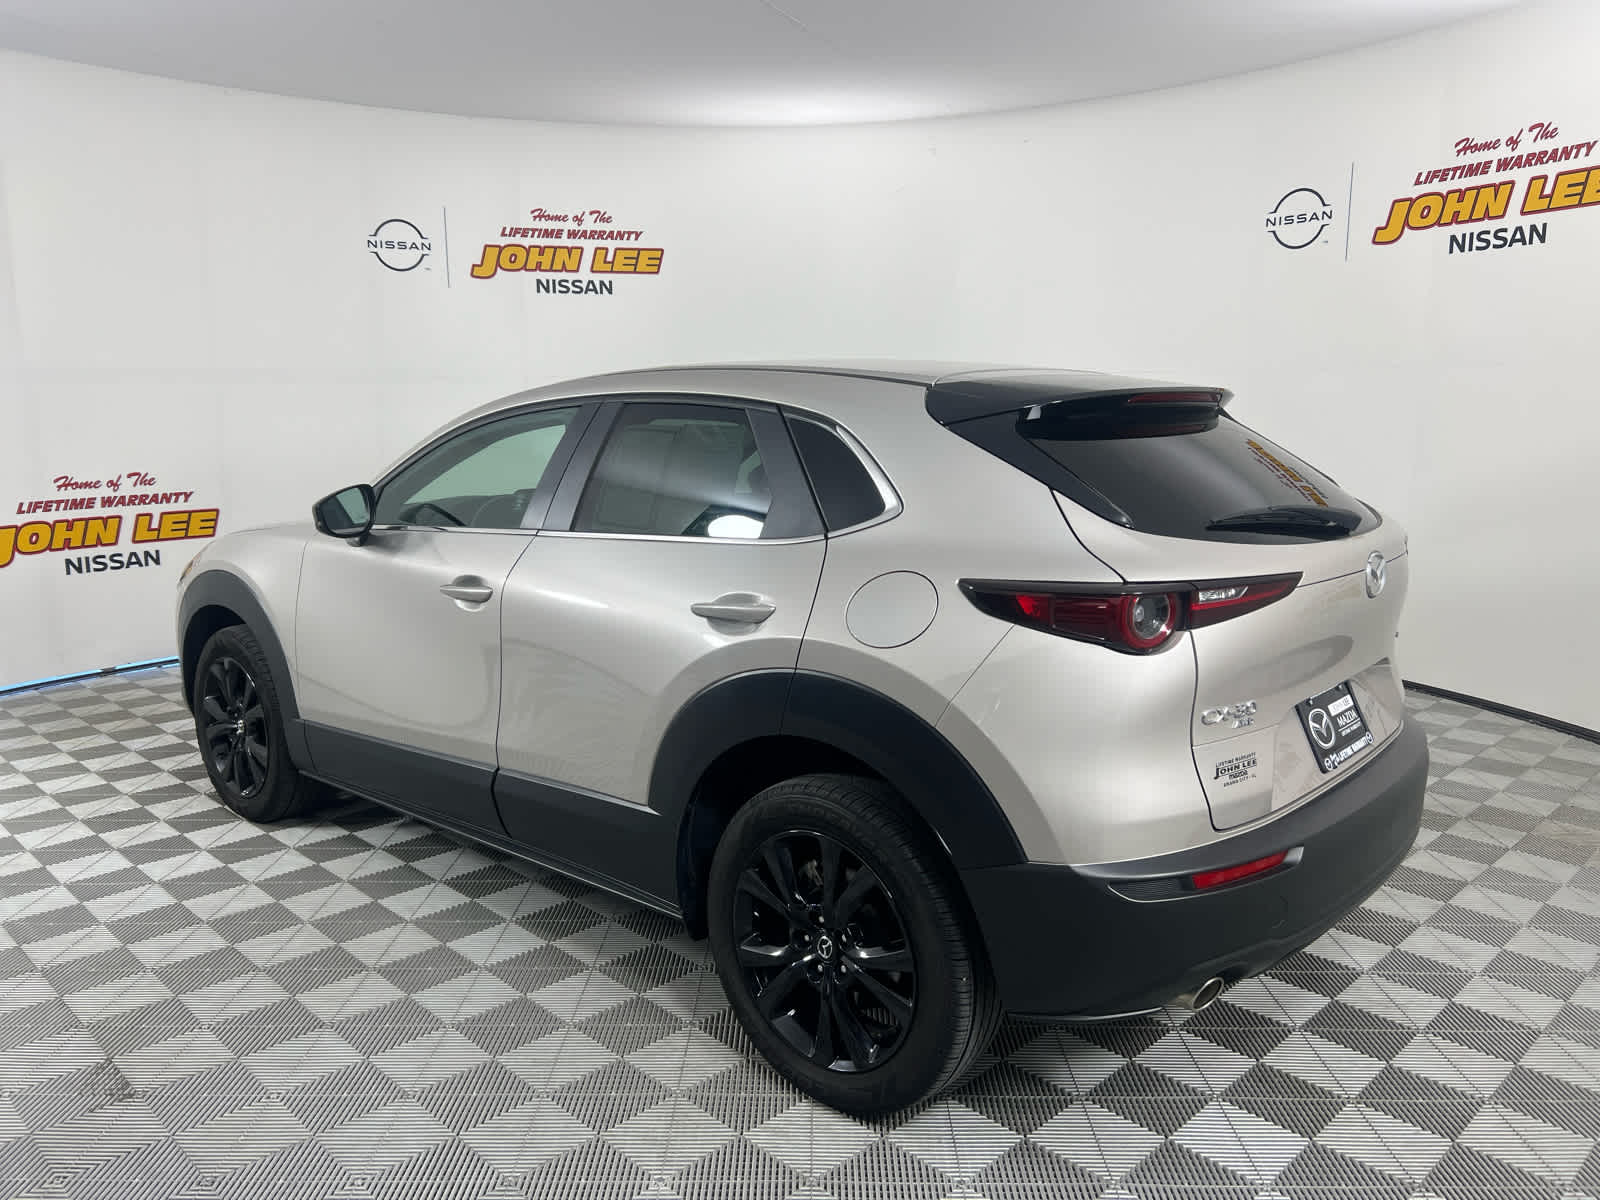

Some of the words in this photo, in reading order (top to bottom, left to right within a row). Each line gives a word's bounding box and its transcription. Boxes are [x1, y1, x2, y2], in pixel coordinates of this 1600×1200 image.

[1454, 137, 1501, 157] Home
[1505, 128, 1523, 152] of
[1528, 121, 1559, 143] The
[1414, 160, 1492, 186] LIFETIME
[1496, 140, 1599, 173] WARRANTY
[530, 208, 569, 224] Home
[572, 211, 586, 225] of
[589, 209, 614, 224] The
[1265, 209, 1333, 228] NISSAN
[1371, 180, 1516, 245] JOHN
[500, 226, 564, 240] LIFETIME
[567, 229, 644, 241] WARRANTY
[1449, 222, 1548, 254] NISSAN
[367, 239, 432, 251] NISSAN
[470, 244, 585, 279] JOHN
[590, 247, 665, 274] LEE
[535, 278, 614, 295] NISSAN
[53, 476, 102, 492] Home
[106, 474, 122, 492] of
[127, 472, 156, 487] The
[16, 497, 96, 515] LIFETIME
[100, 491, 194, 509] WARRANTY
[132, 508, 220, 544] LEE
[64, 550, 161, 575] NISSAN
[1337, 709, 1358, 728] MAZDA
[1213, 762, 1240, 780] JOHN
[1242, 759, 1257, 768] LEE
